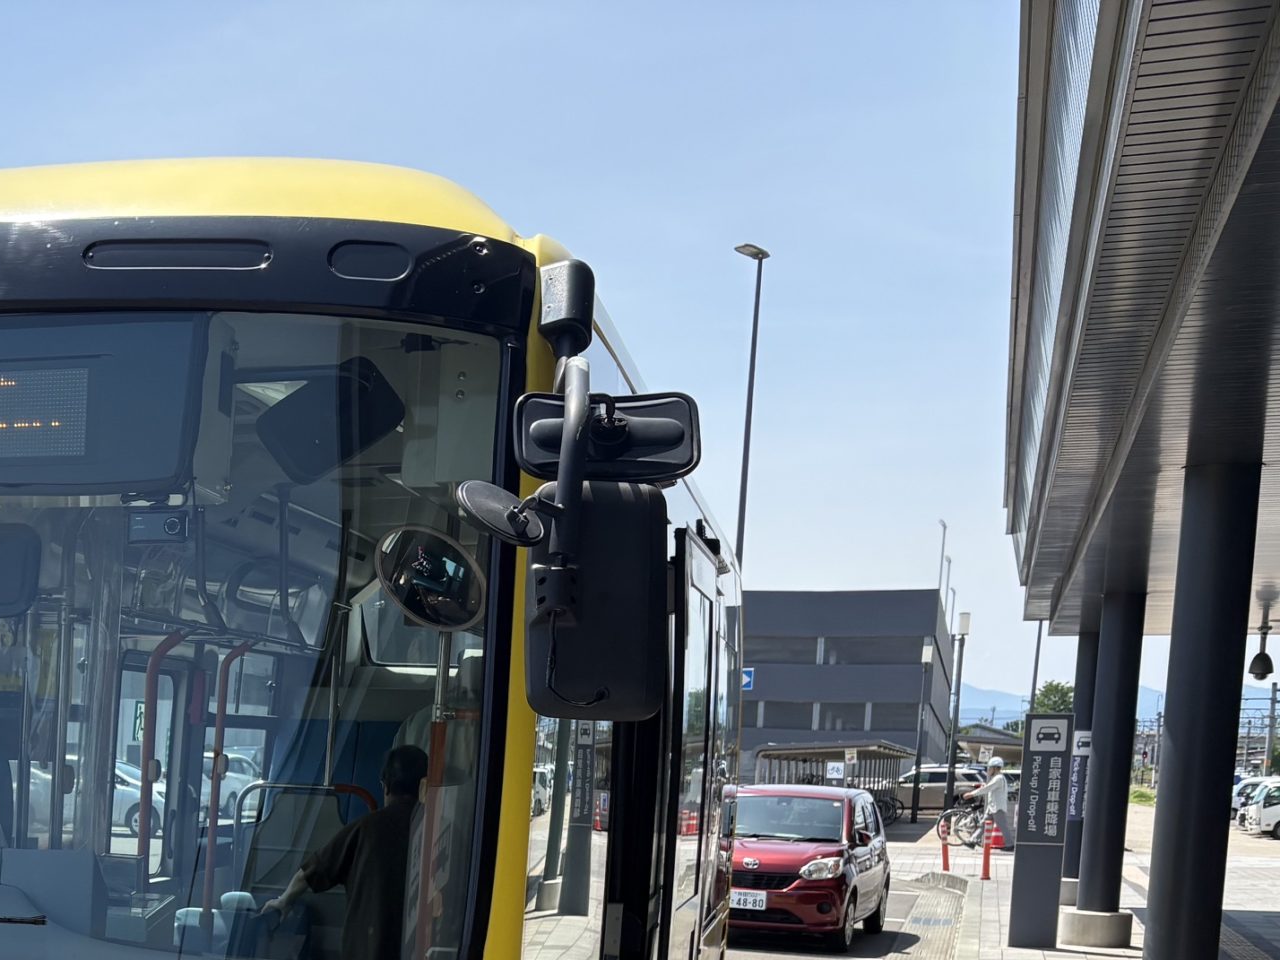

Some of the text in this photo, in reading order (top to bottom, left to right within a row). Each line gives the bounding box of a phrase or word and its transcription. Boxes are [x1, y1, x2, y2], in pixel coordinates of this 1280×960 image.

[1029, 756, 1042, 788] Pick-up
[1027, 795, 1039, 831] Drop-off
[1043, 757, 1062, 837] 自家用車乗降場
[736, 897, 764, 908] 48-80
